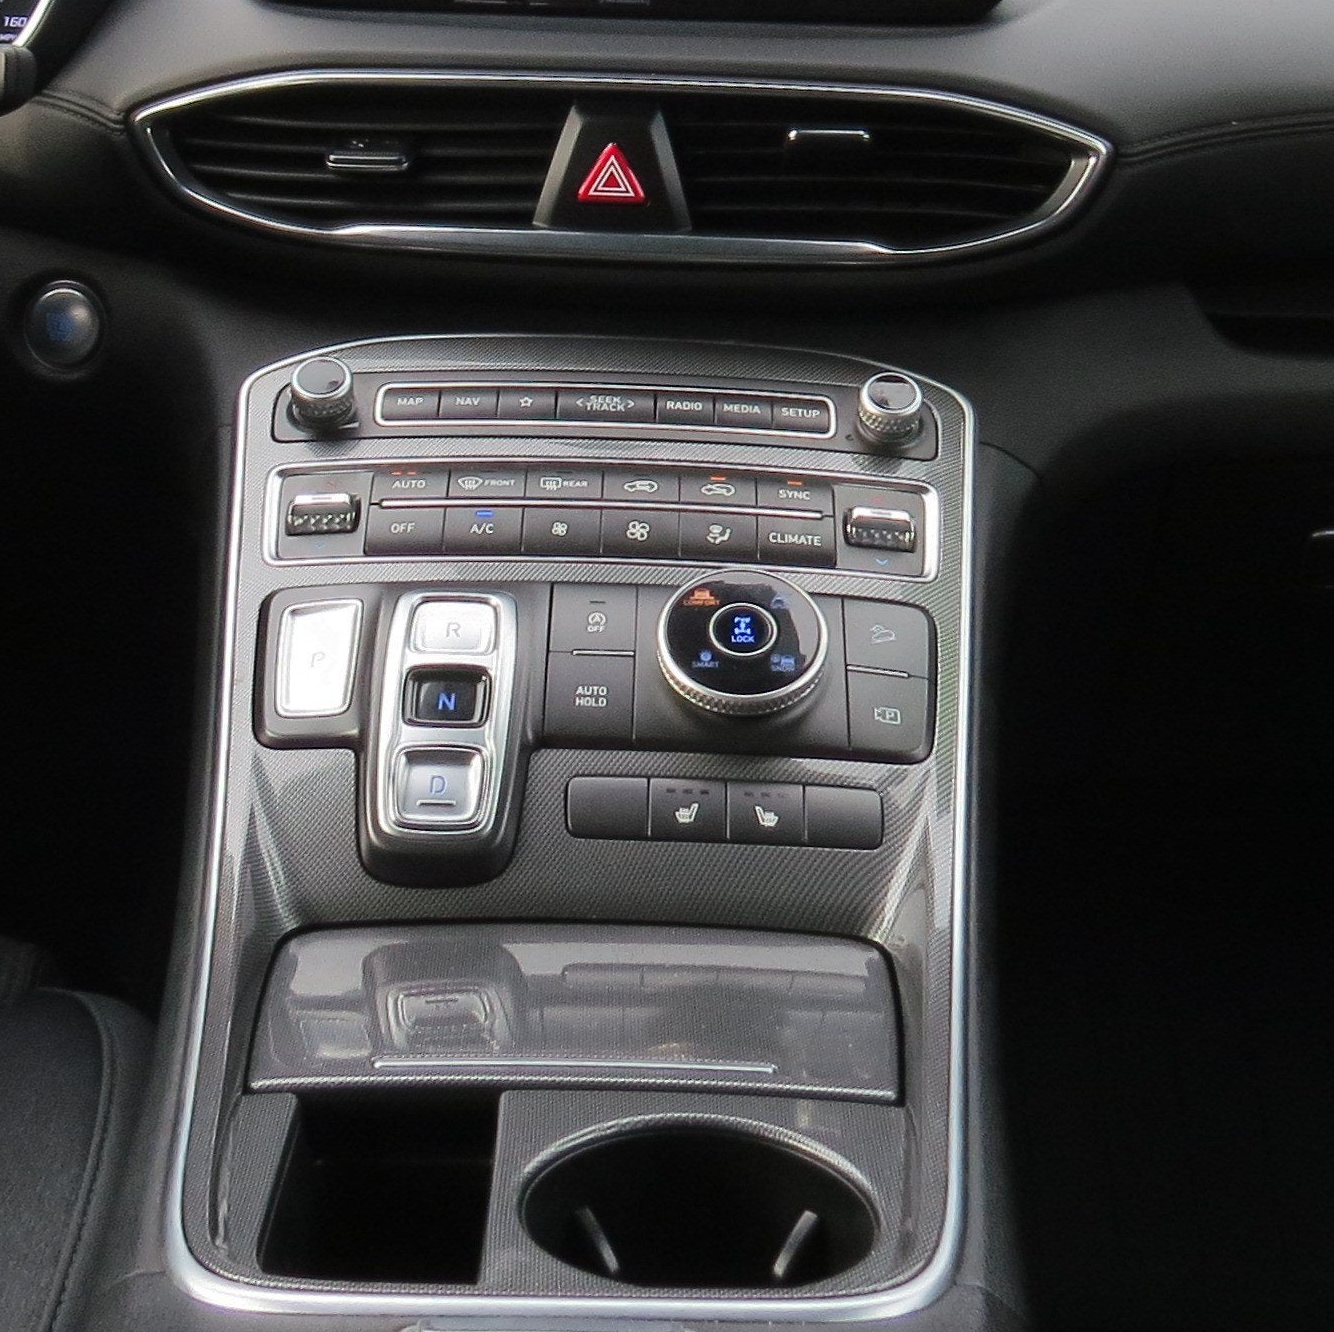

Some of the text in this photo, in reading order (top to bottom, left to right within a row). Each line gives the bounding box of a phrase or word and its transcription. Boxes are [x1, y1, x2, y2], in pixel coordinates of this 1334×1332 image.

[4, 16, 28, 27] 160
[397, 396, 424, 406] MAP
[455, 396, 480, 406] NAV
[589, 394, 622, 403] SEEK
[586, 402, 625, 412] TRACK
[666, 400, 703, 412] RADIO
[723, 403, 761, 415] MEDIA
[781, 407, 820, 419] SETUP
[392, 478, 426, 490] AUTO
[484, 478, 515, 488] FRONT
[563, 478, 588, 488] REAR
[779, 488, 810, 501] SYNC
[390, 522, 415, 534] OFF
[469, 522, 494, 535] A/C
[769, 532, 822, 547] CLIMATE
[446, 622, 461, 639] R
[587, 623, 606, 633] OFF
[731, 635, 755, 643] LOCK
[311, 652, 326, 668] P
[576, 686, 608, 696] AUTO
[437, 693, 457, 710] N
[575, 696, 608, 708] HOLD
[429, 774, 446, 796] D
